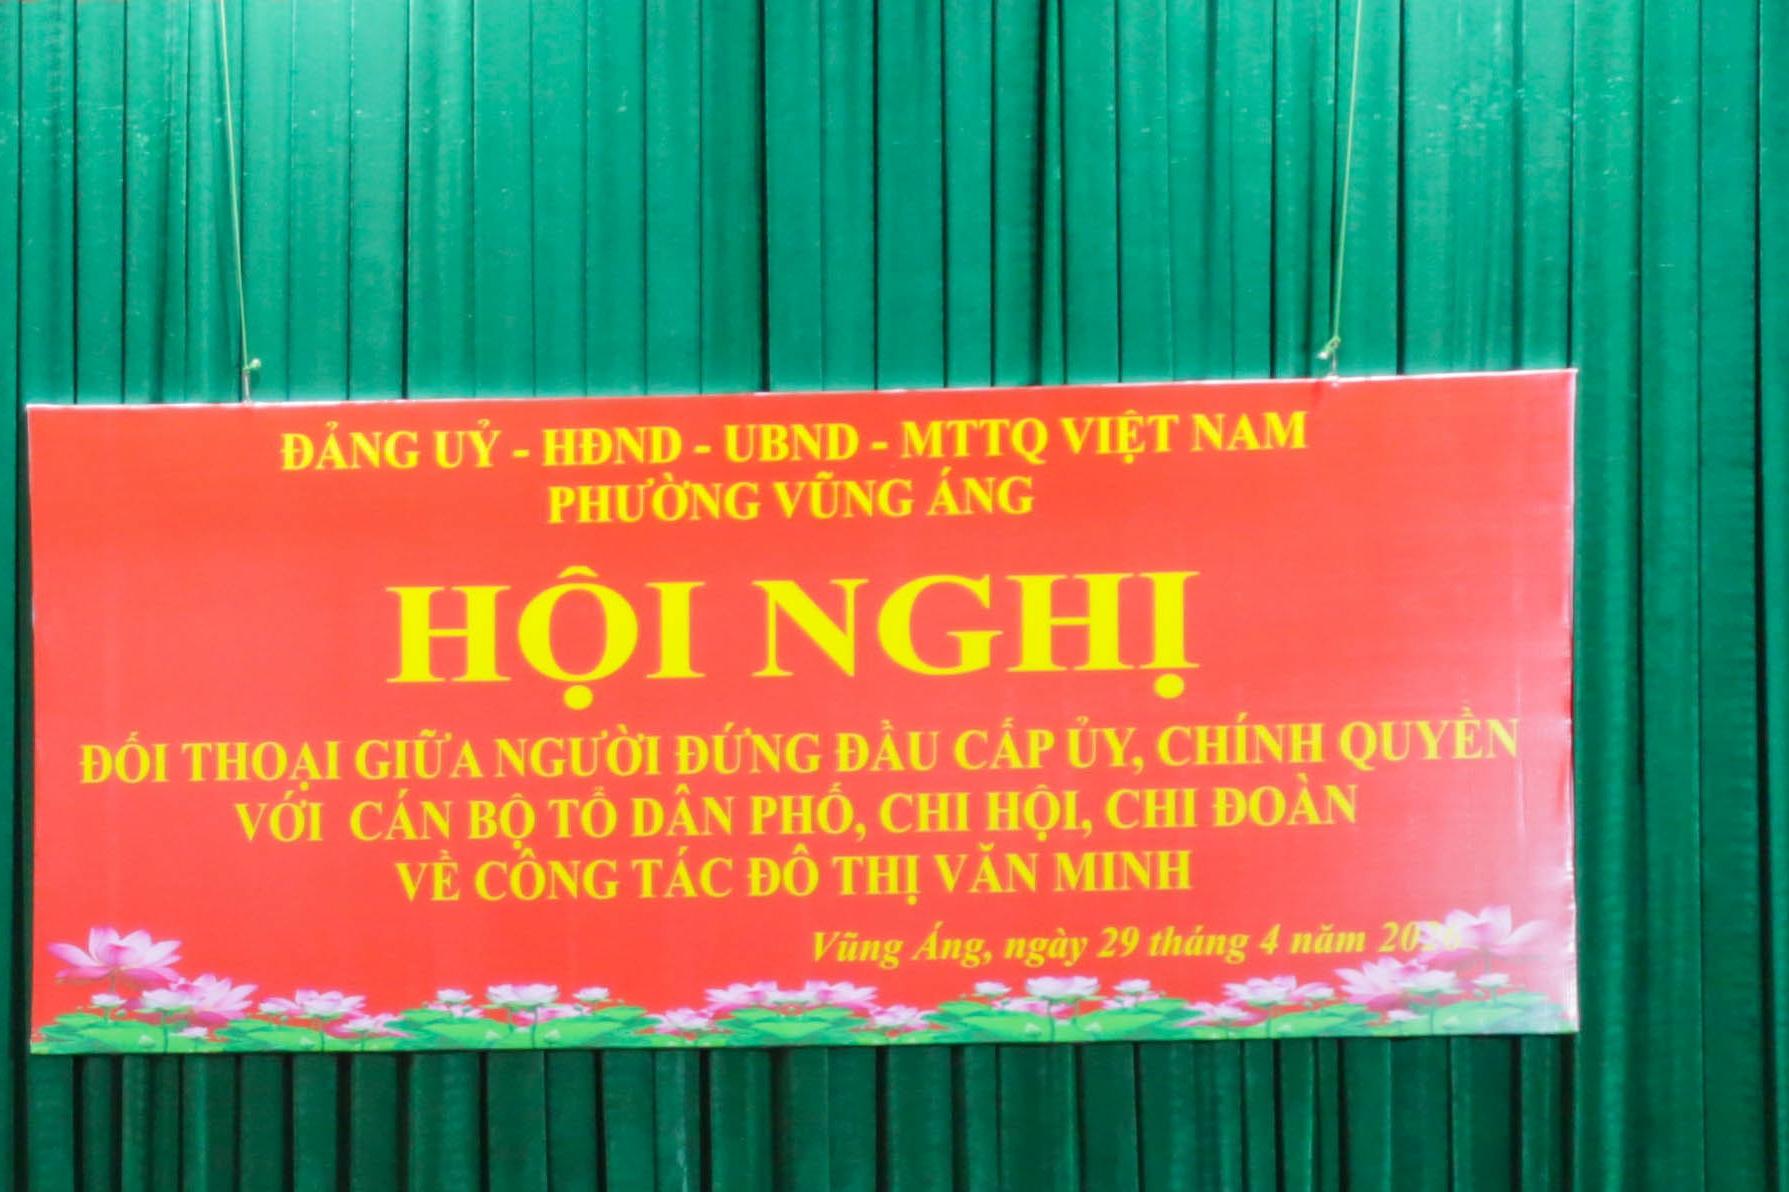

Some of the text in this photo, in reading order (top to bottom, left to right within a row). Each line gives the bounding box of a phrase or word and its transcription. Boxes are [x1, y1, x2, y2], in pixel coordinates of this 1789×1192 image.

[280, 409, 1307, 470] ĐẢNG UỶ - HĐND - UBND - MTTQ VIỆT NAM
[548, 466, 1034, 523] PHƯỜNG VŨNG ÁNG
[386, 565, 1200, 710] HỘI NGHỊ
[79, 706, 1520, 791] ĐỐI THOẠI GIỮA NGƯỜI ĐỨNG ĐẦU CẤP ỦY, CHÍNH QUYỀN
[234, 773, 1358, 850] VỚI CÁN BỘ TỔ DÂN PHỐ, CHI HỘI, CHI ĐOÀN
[395, 842, 1191, 906] VỀ CÔNG TÁC ĐÔ THỊ VĂN MINH
[812, 930, 903, 970] Vũng
[910, 920, 993, 968] Áng,
[1004, 927, 1088, 967] ngày
[1097, 925, 1140, 958] 29
[1147, 925, 1250, 965] tháng
[1259, 923, 1282, 955] 4
[1291, 924, 1366, 954] năm
